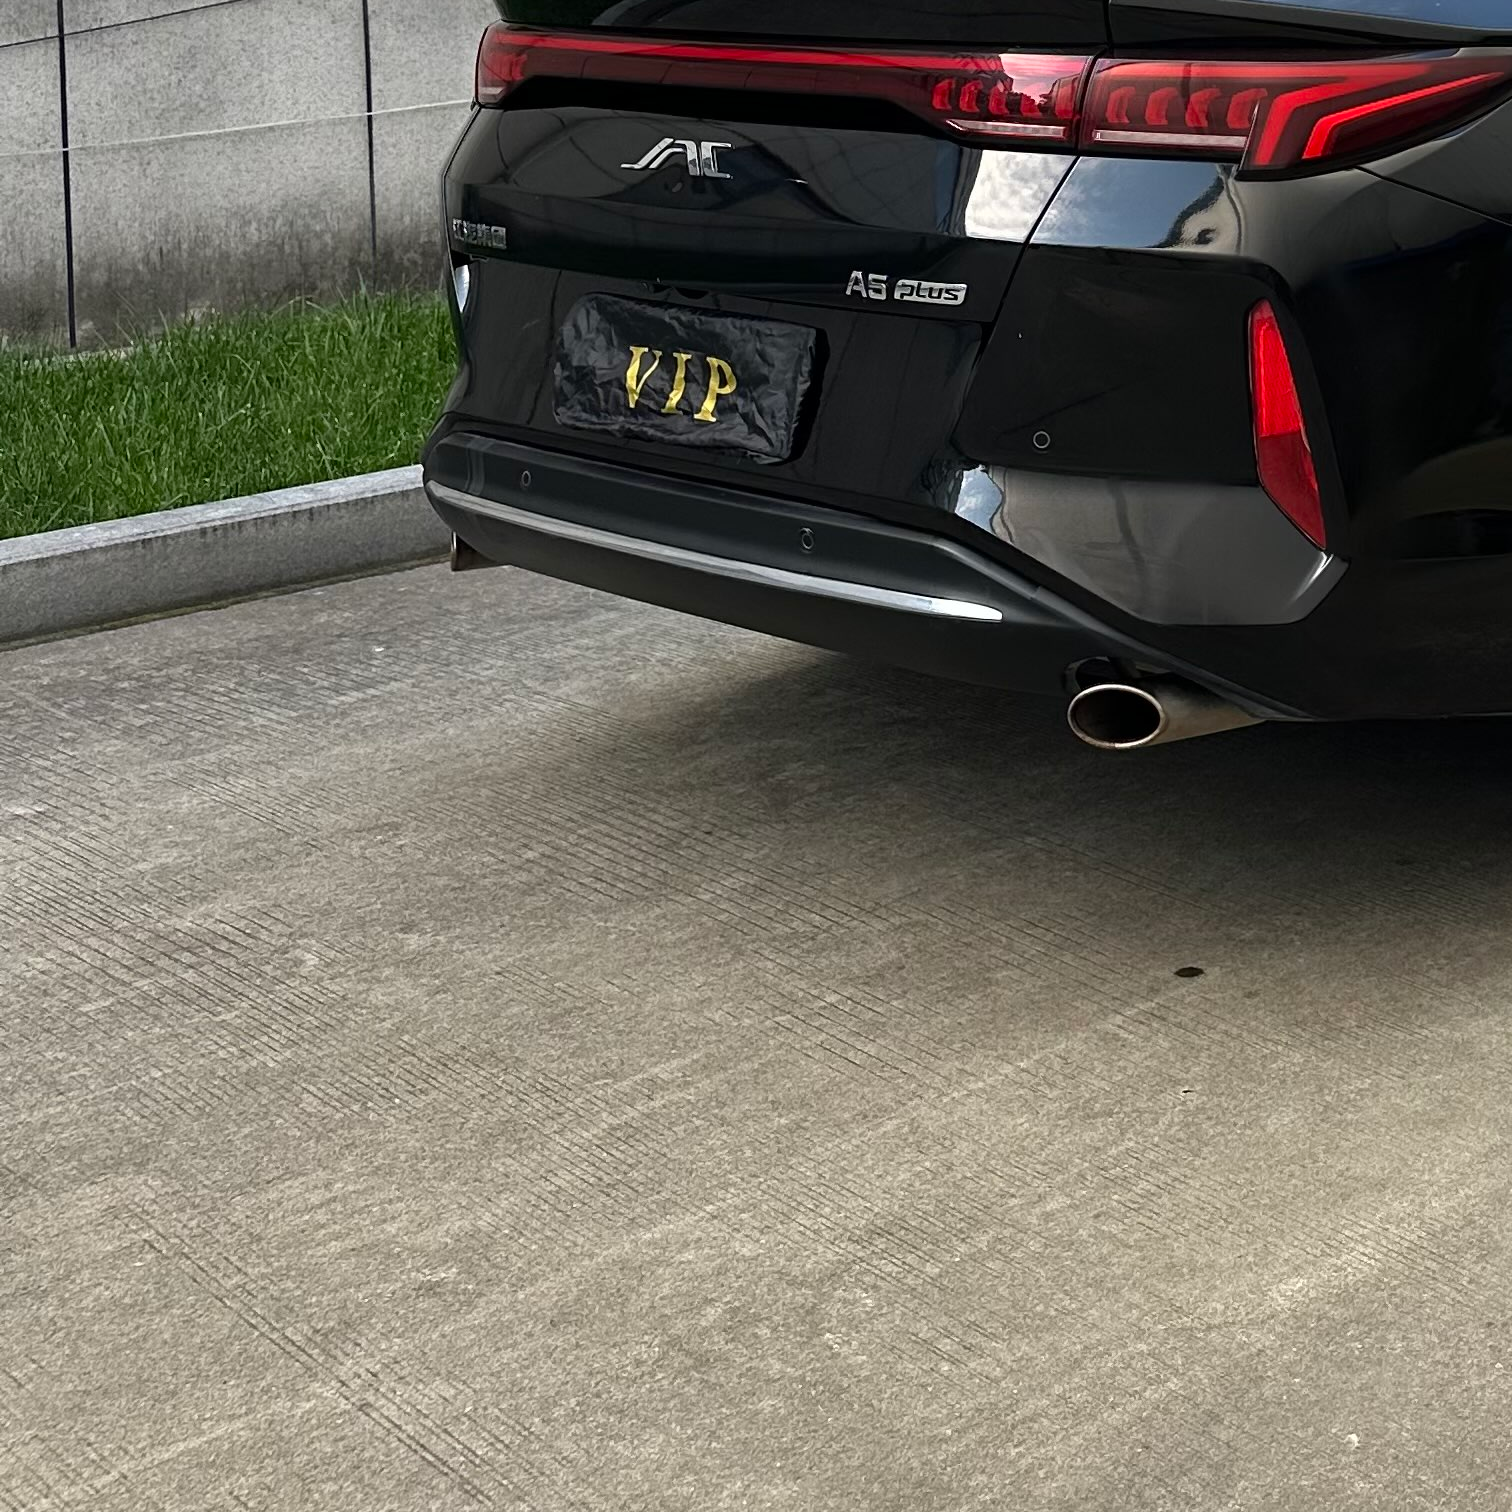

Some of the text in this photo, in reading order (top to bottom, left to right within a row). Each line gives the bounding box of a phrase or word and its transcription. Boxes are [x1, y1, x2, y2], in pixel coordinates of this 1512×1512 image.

[845, 270, 965, 303] A5 plus
[625, 345, 737, 422] VIP
